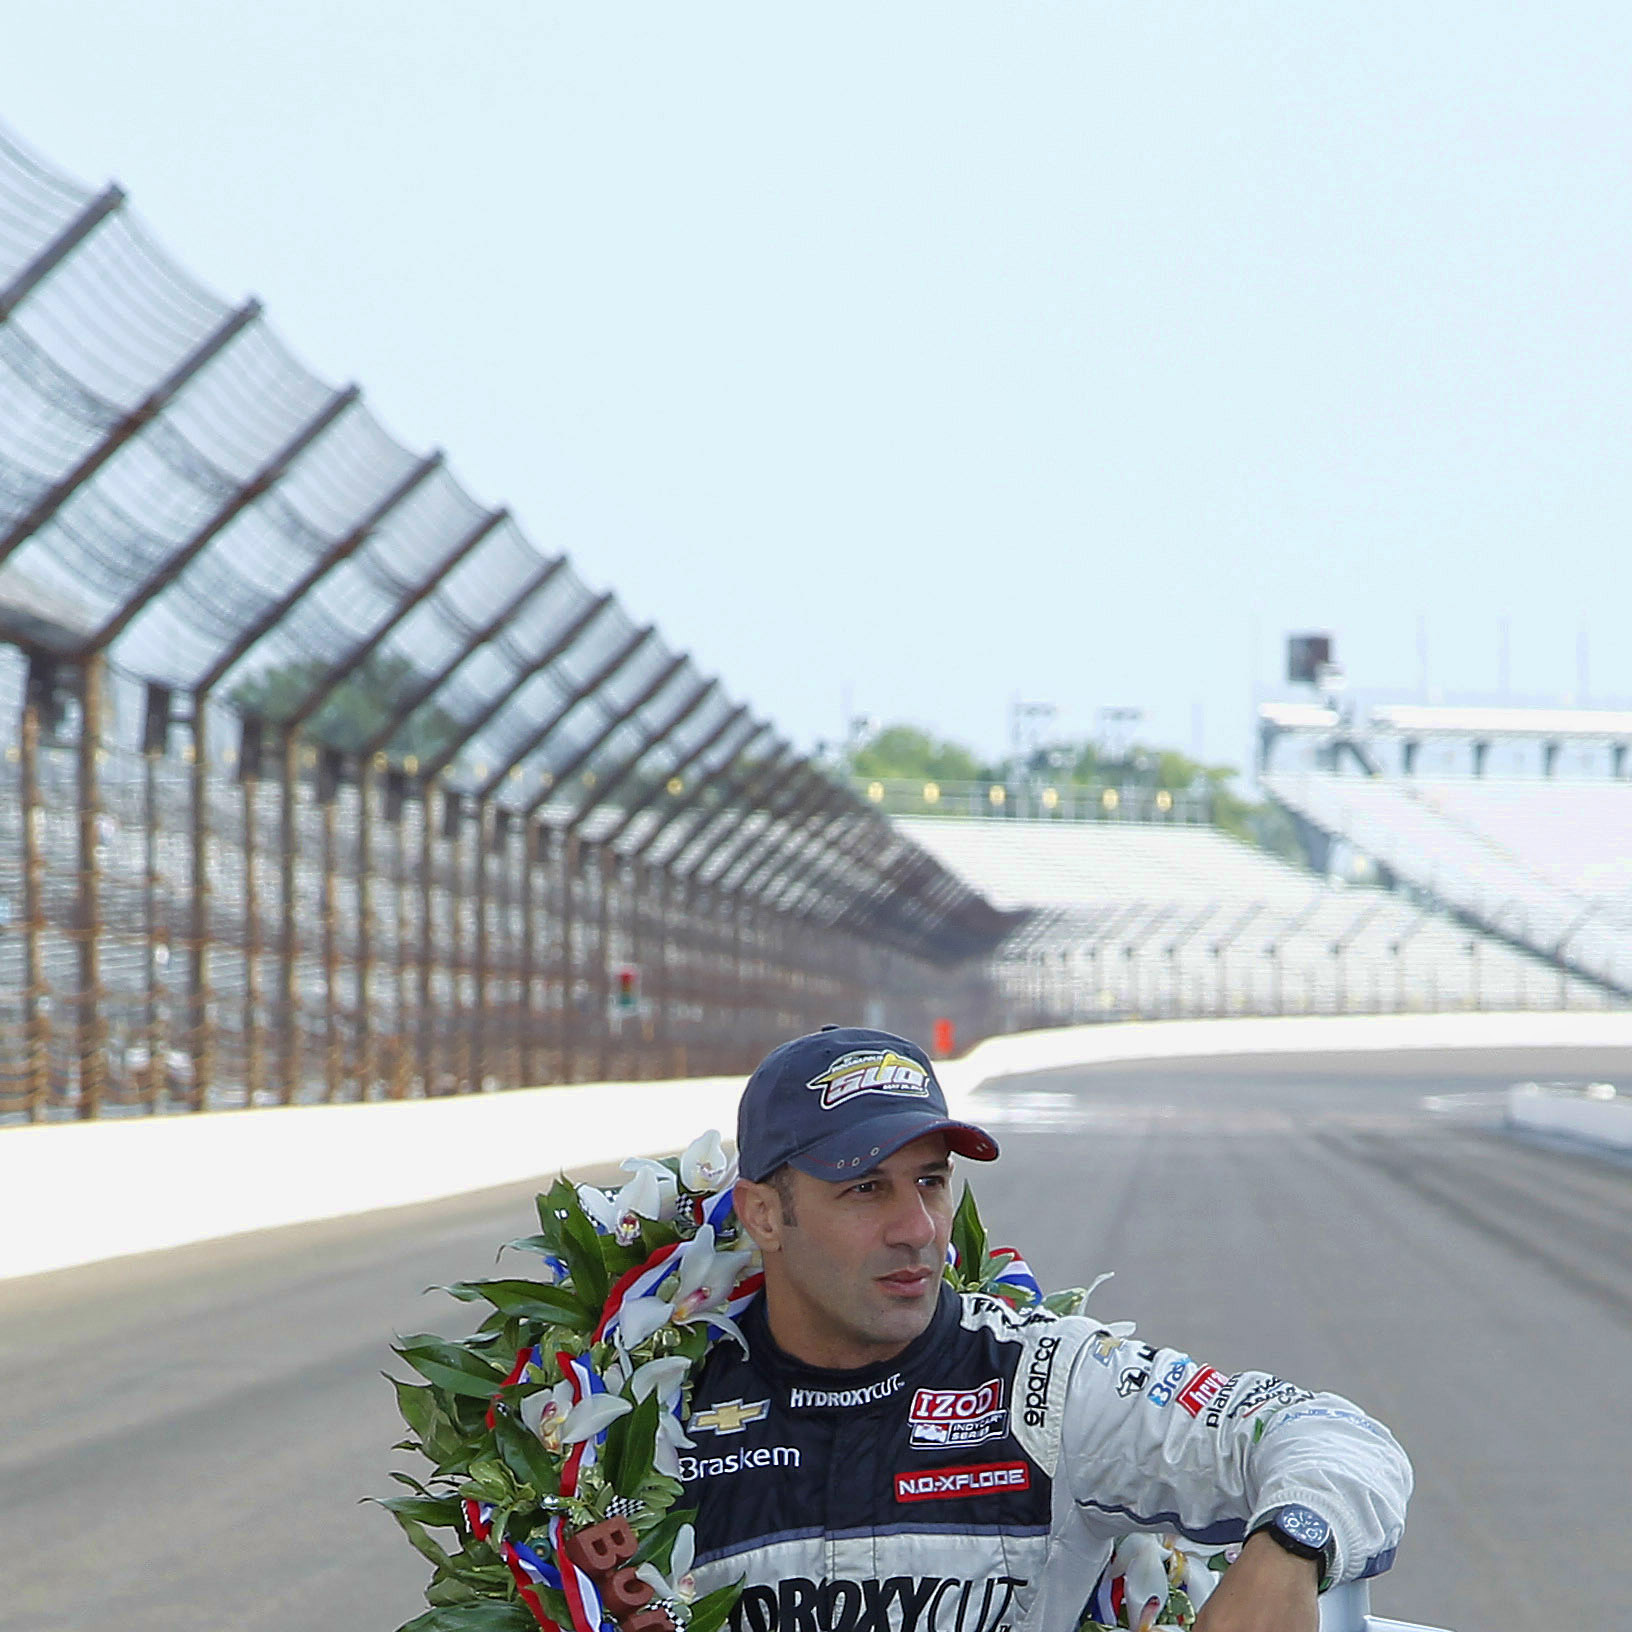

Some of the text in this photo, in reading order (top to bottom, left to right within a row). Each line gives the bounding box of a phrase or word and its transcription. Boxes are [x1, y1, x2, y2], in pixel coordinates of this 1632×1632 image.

[790, 1373, 902, 1408] HYDROXYCUT
[1023, 1336, 1062, 1428] sparco
[916, 1387, 993, 1417] IZOD
[678, 1446, 800, 1483] Braskem
